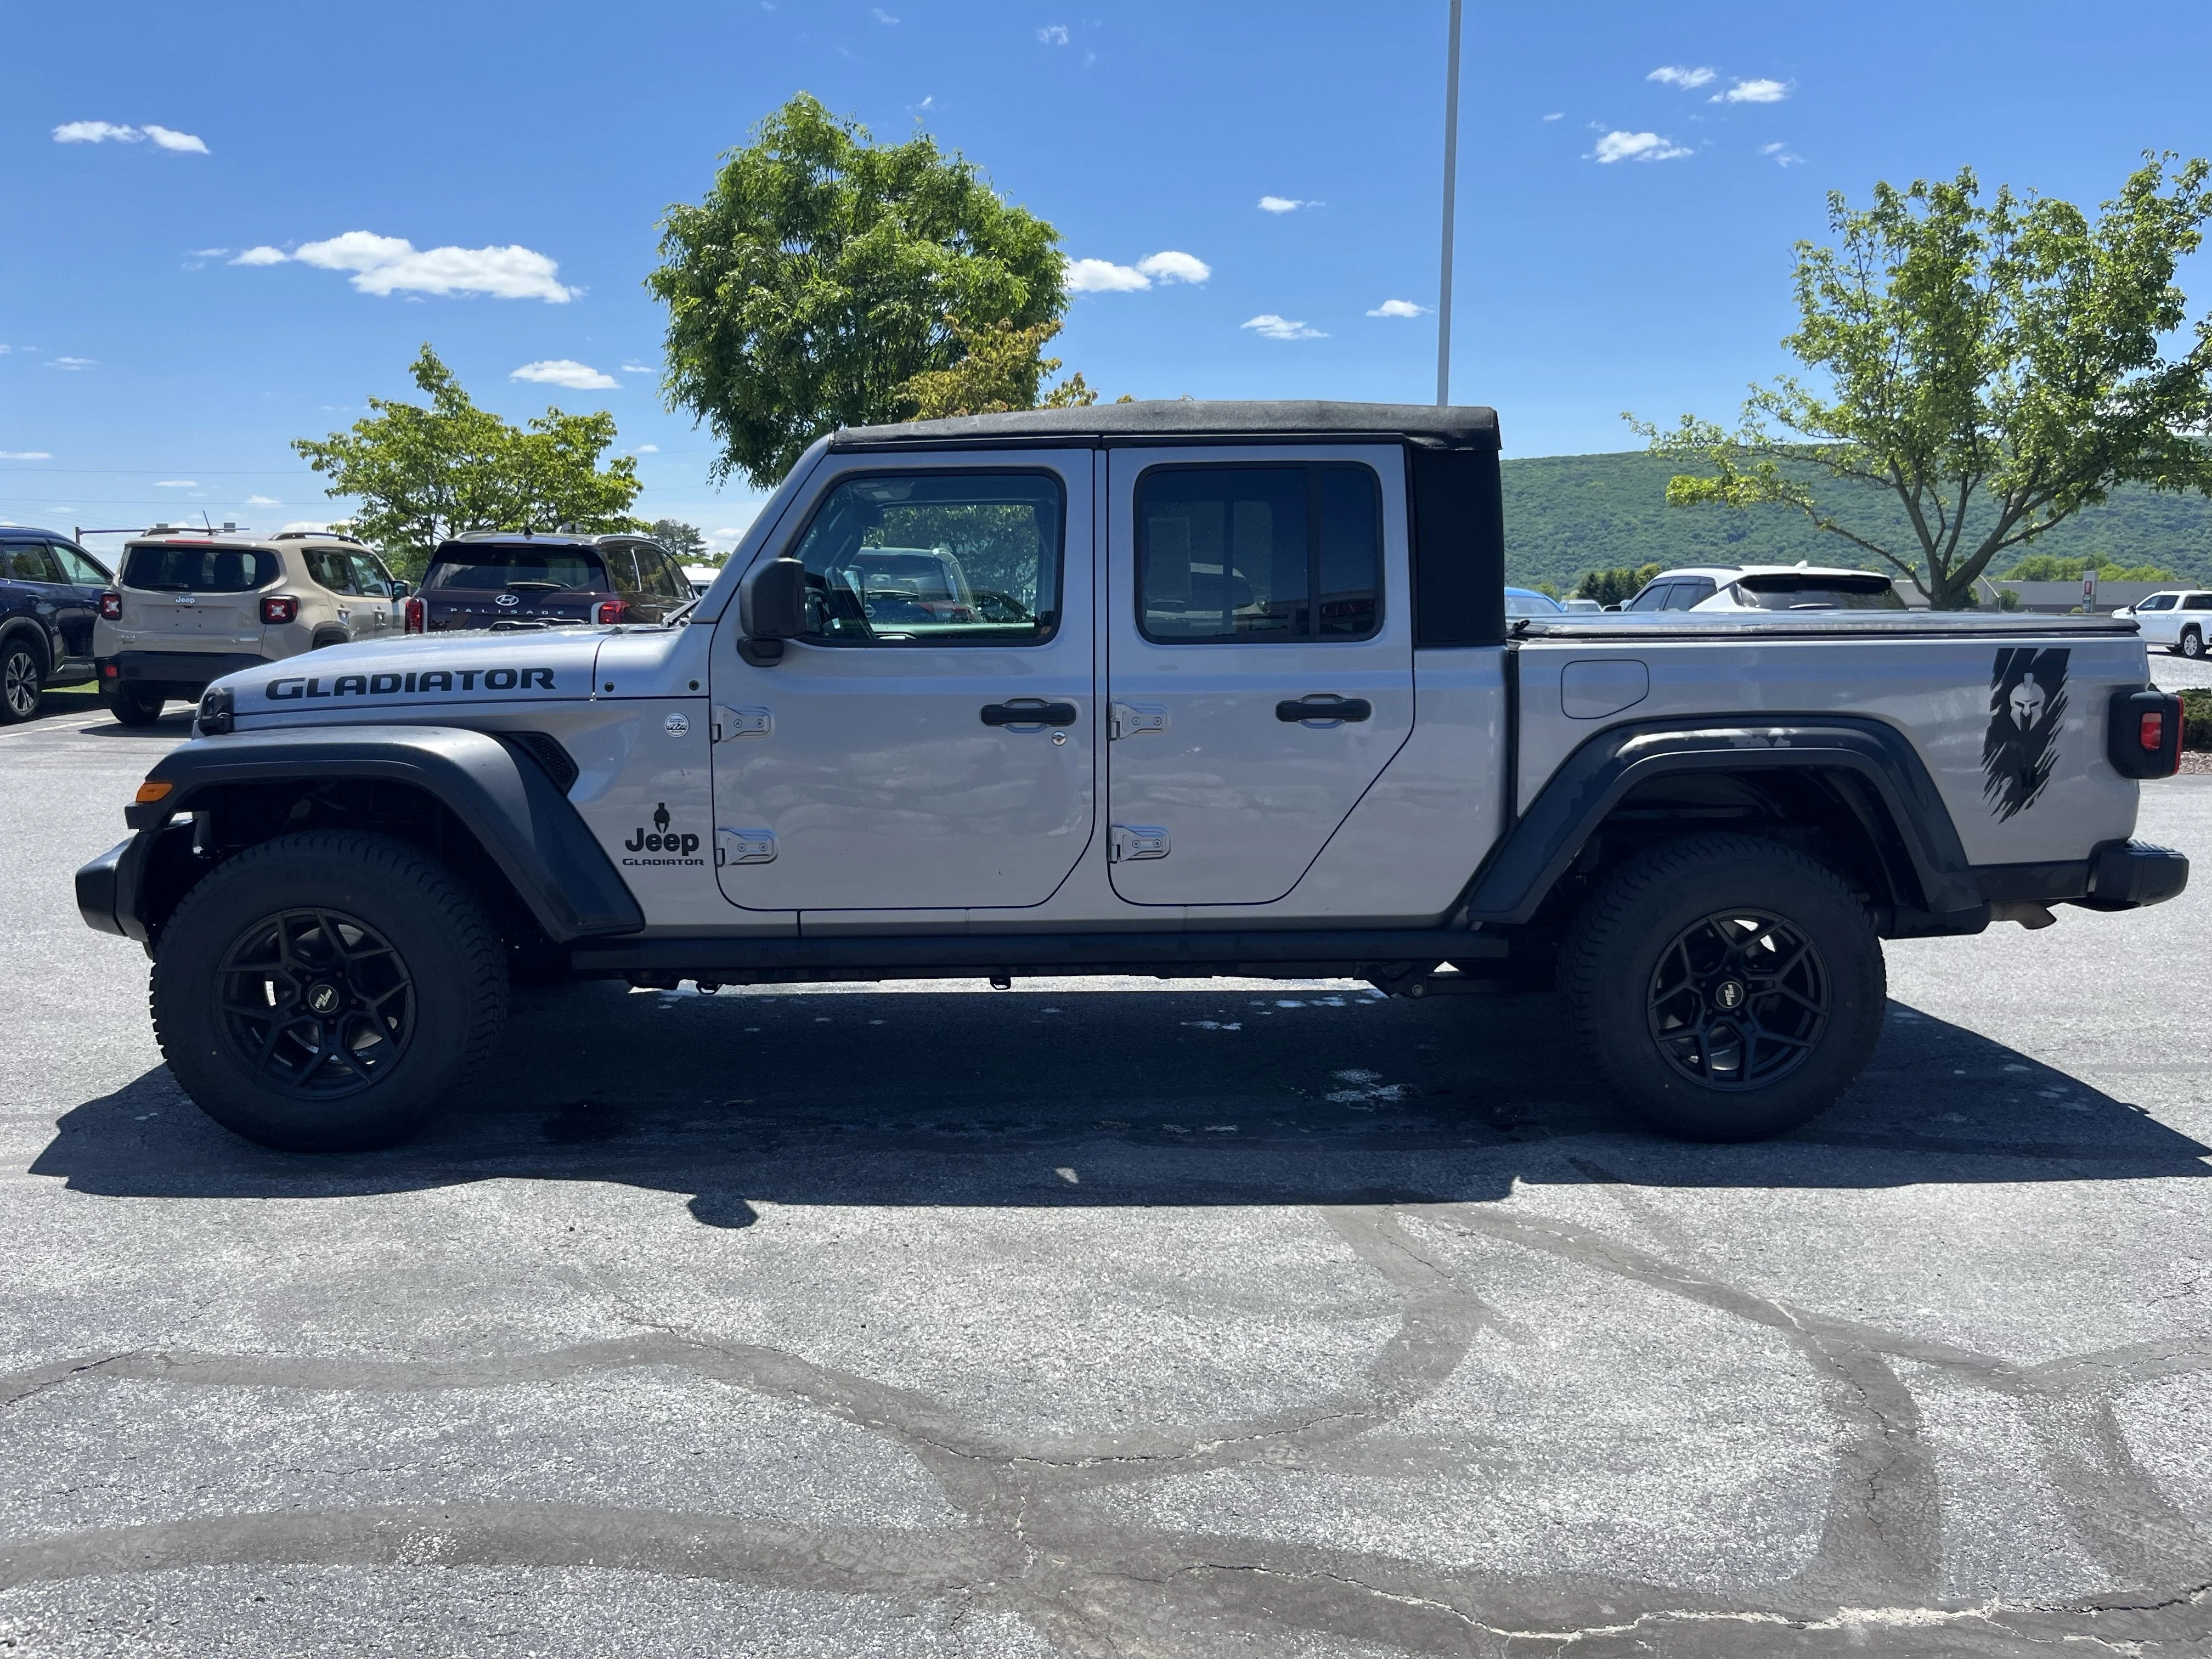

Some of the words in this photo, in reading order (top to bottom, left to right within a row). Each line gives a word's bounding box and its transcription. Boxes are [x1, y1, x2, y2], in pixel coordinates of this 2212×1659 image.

[176, 596, 195, 604] Jeep
[266, 668, 556, 700] GLADIATOR
[625, 827, 699, 856] Jeep
[321, 989, 332, 1007] ROCK
